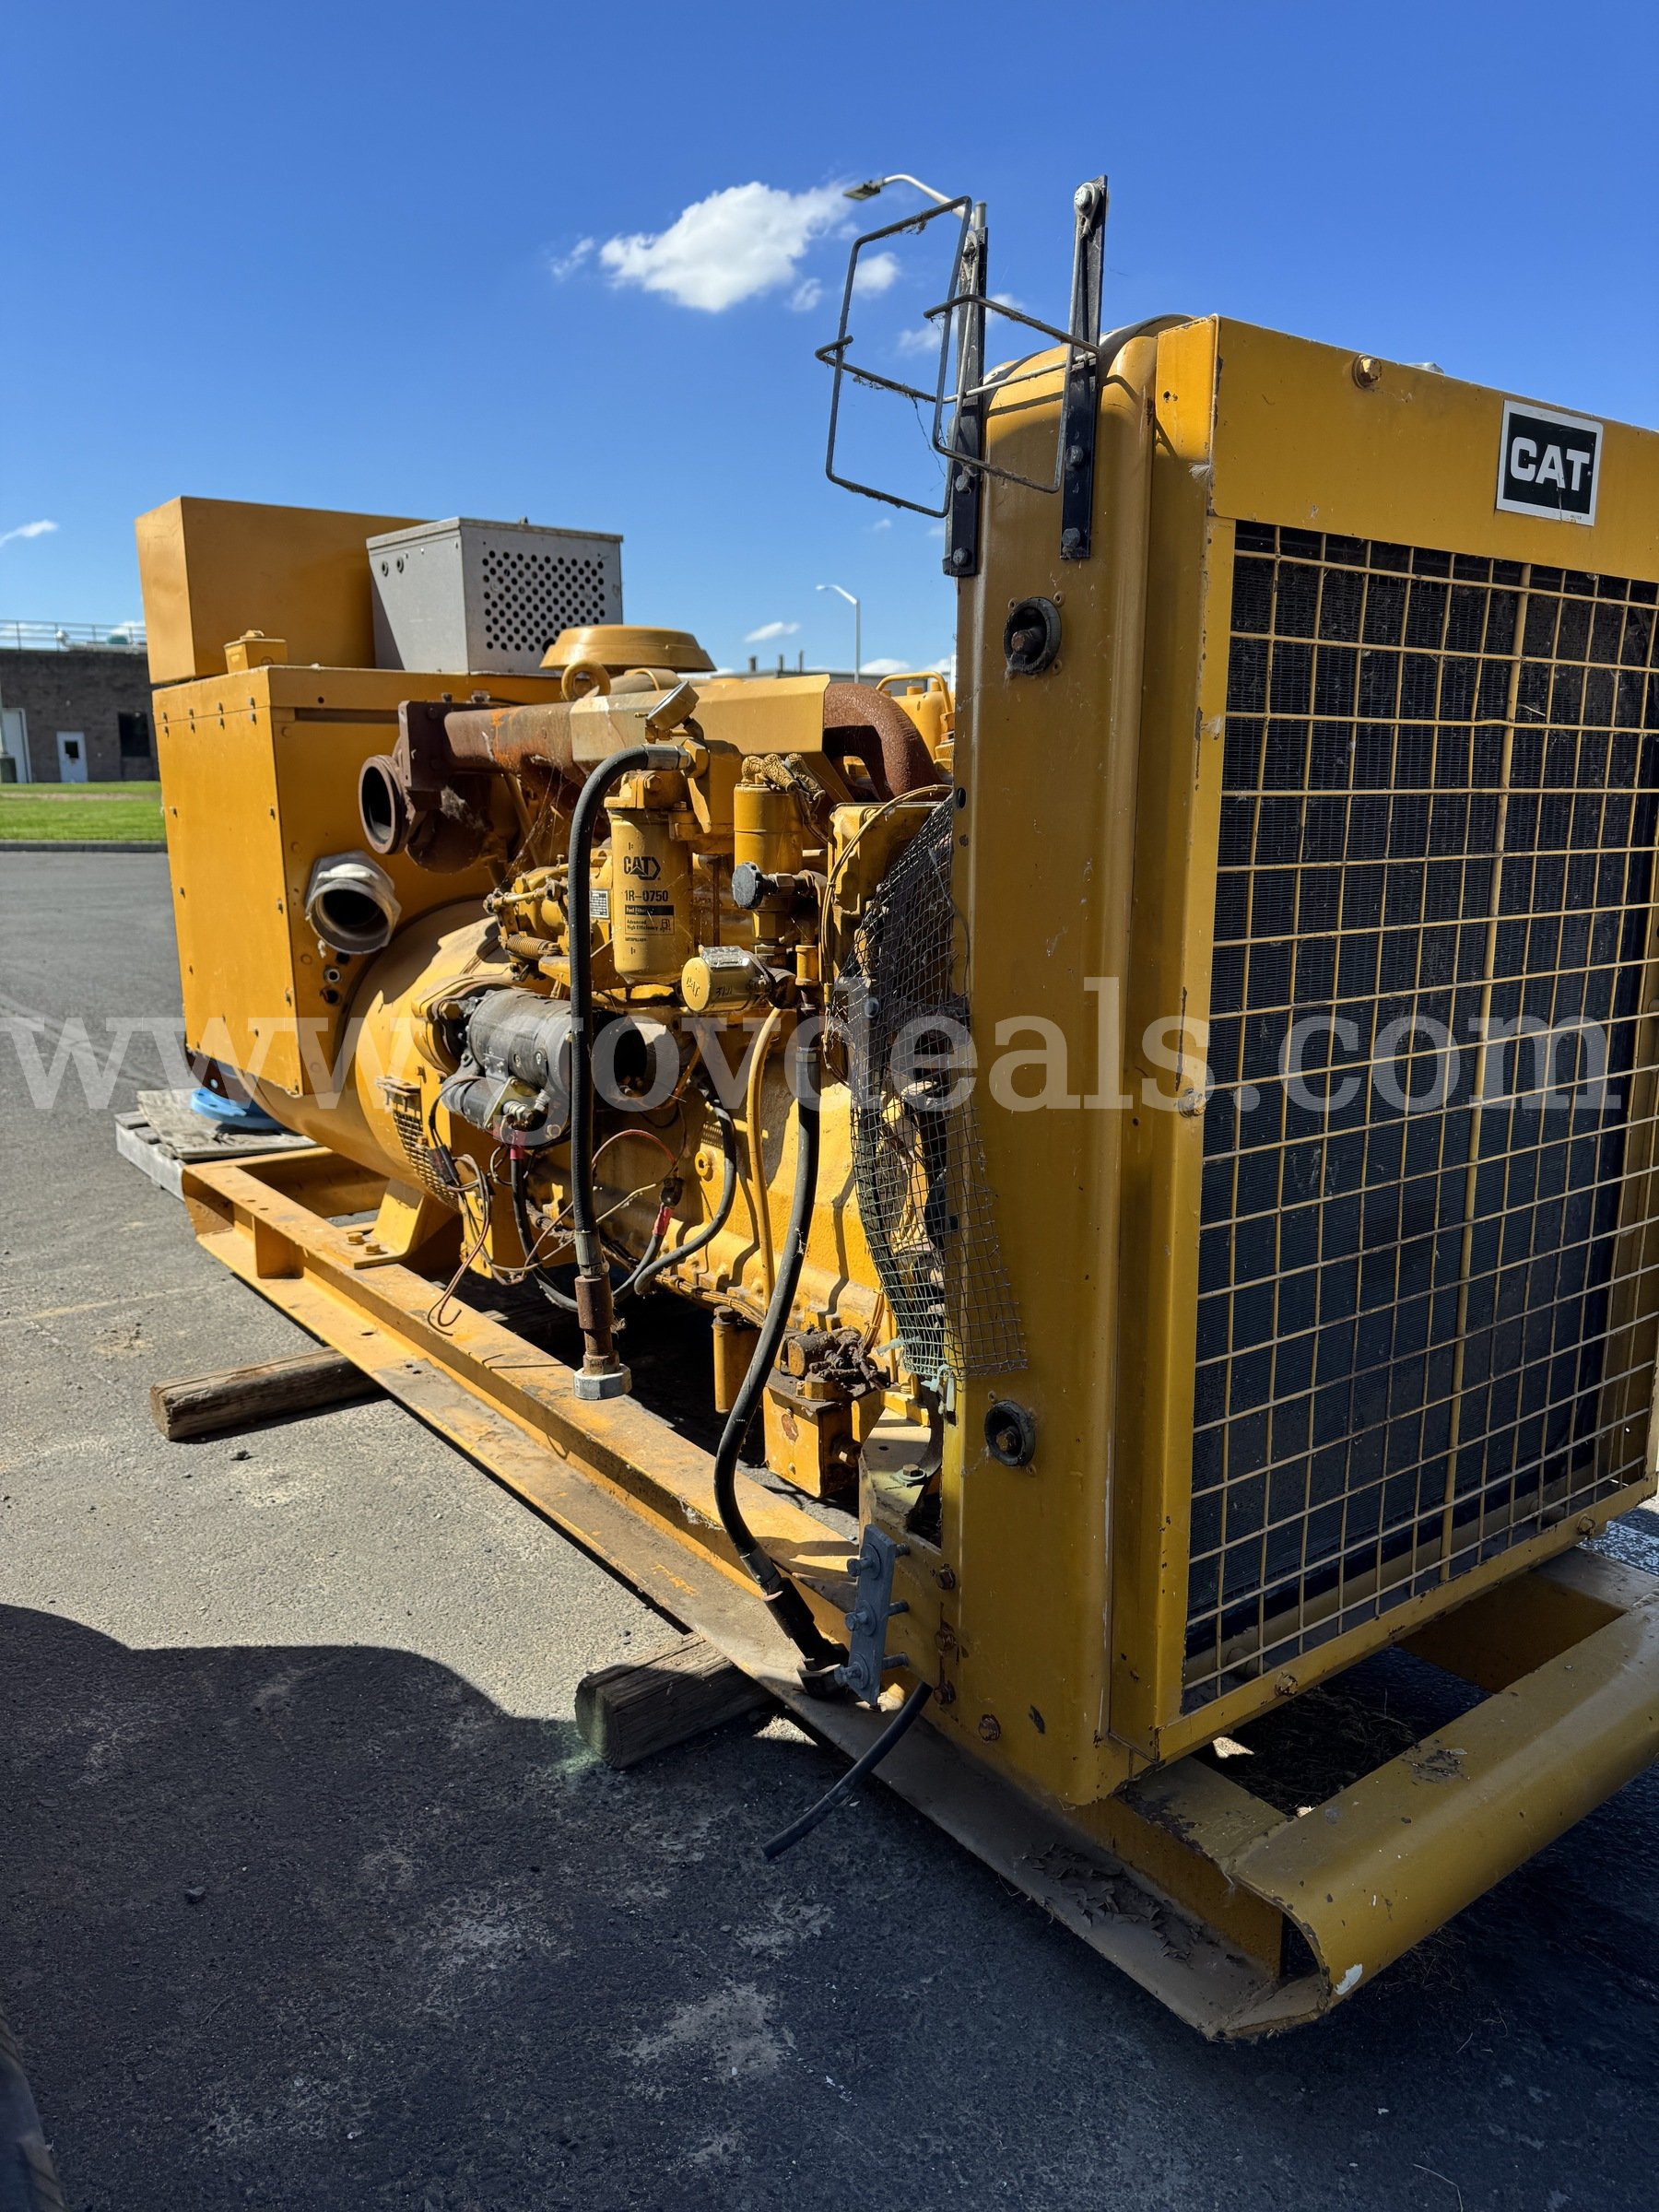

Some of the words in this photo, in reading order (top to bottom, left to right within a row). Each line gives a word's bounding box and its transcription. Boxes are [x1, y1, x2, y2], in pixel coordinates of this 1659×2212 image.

[1511, 437, 1590, 491] CAT
[624, 855, 653, 877] CAT
[625, 889, 669, 902] 1R-0750
